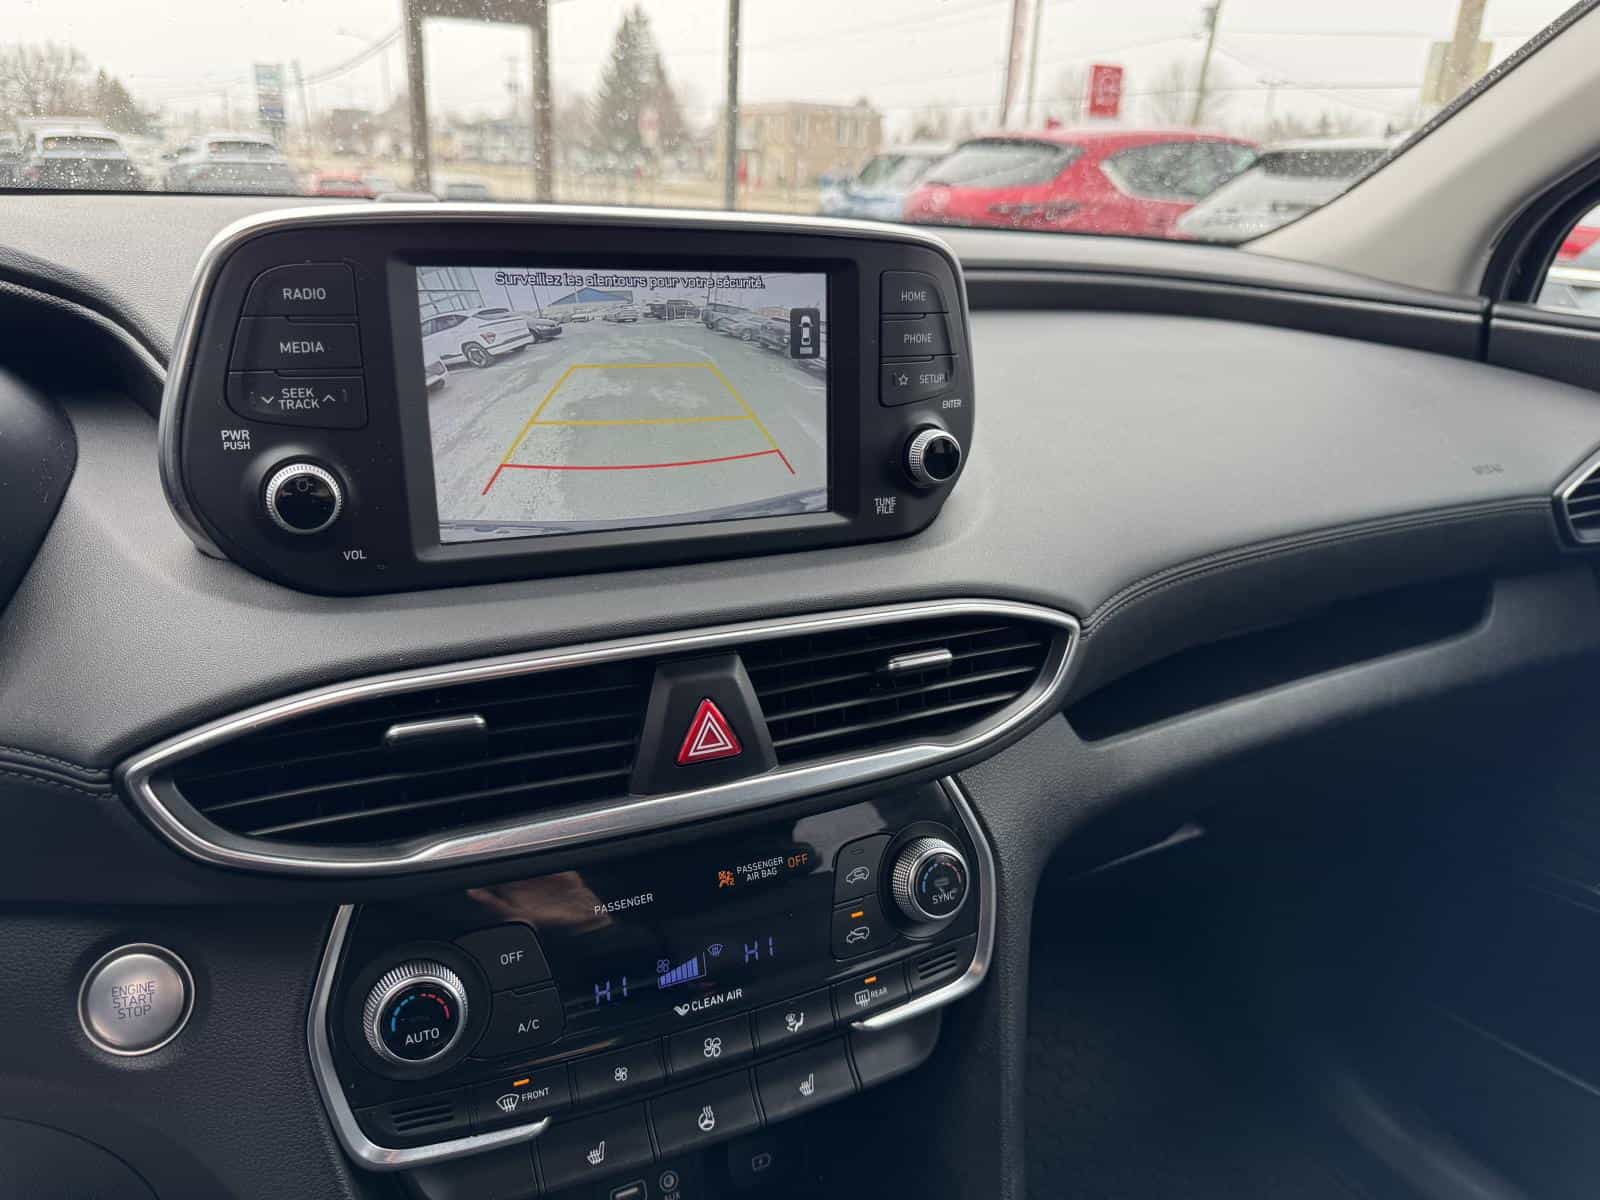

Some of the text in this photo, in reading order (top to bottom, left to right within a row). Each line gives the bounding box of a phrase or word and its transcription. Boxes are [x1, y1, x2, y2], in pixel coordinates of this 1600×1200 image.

[495, 271, 562, 287] Surveillez
[563, 273, 583, 287] les
[586, 272, 647, 288] alentours
[649, 276, 680, 291] pour
[681, 276, 715, 289] votre
[282, 287, 327, 301] RADIO
[901, 290, 928, 302] HOME
[903, 332, 934, 345] PHONE
[279, 341, 325, 354] MEDIA
[919, 373, 945, 385] SETUP
[281, 387, 315, 399] SEEK
[278, 399, 320, 411] TRACK
[942, 398, 962, 410] ENTER
[220, 429, 251, 442] PWR
[222, 441, 251, 451] PUSH
[874, 496, 897, 507] TUNE
[876, 505, 896, 515] FILE
[343, 549, 367, 562] VOL
[736, 856, 783, 874] PASSENGER
[787, 853, 808, 868] OFF
[746, 866, 778, 882] AIR BAG
[932, 889, 956, 904] SYNC
[594, 893, 653, 915] PASSENGER
[500, 951, 524, 965] OFF
[112, 981, 155, 997] ENGINE
[870, 986, 887, 998] REAR
[113, 993, 153, 1009] START
[691, 988, 743, 1012] CLEAN AIR
[118, 1005, 151, 1019] STOP
[518, 1018, 540, 1033] A/C
[405, 1027, 440, 1046] AUTO
[521, 1088, 550, 1101] FRONT
